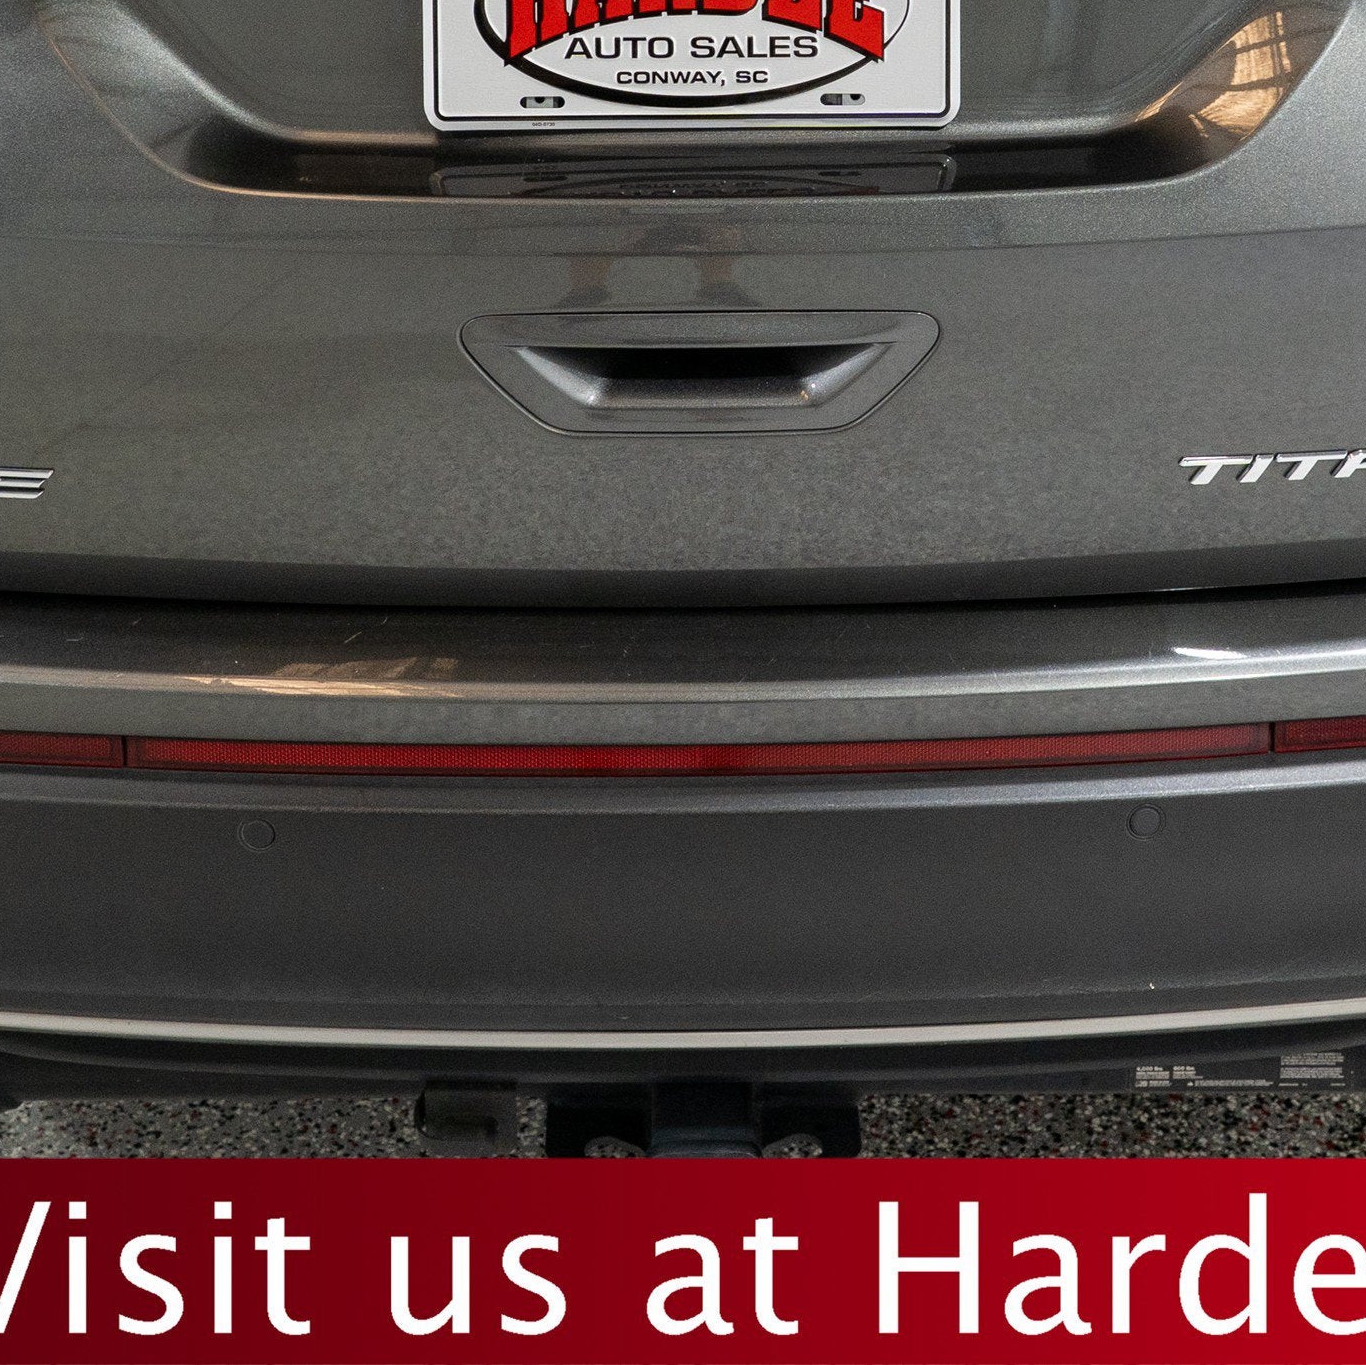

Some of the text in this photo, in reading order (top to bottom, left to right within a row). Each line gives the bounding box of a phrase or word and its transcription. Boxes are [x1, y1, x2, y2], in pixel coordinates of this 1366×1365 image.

[564, 35, 819, 60] AUTO SALES
[616, 70, 768, 87] CONWAY, SC
